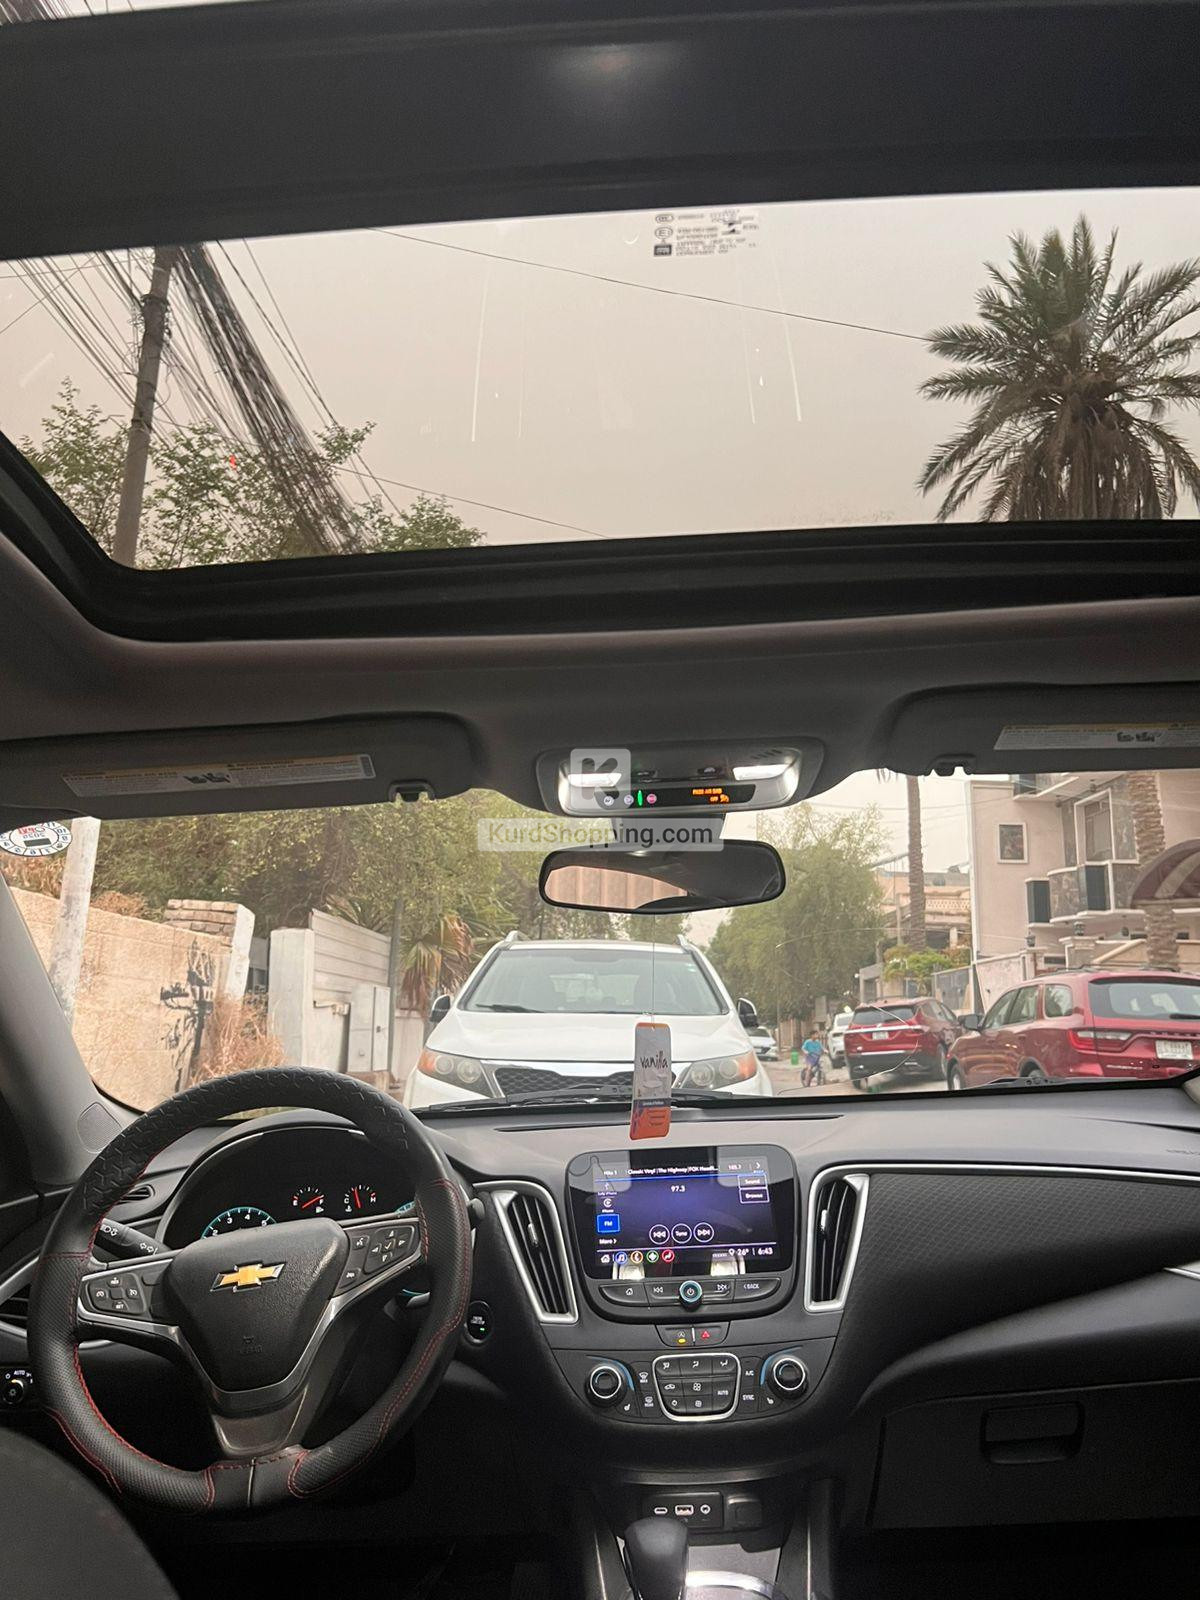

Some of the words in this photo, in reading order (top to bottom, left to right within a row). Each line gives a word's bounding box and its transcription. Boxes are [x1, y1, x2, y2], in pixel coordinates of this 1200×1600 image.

[639, 1050, 669, 1069] vanilla
[226, 1217, 233, 1225] 3
[244, 1213, 251, 1221] 4
